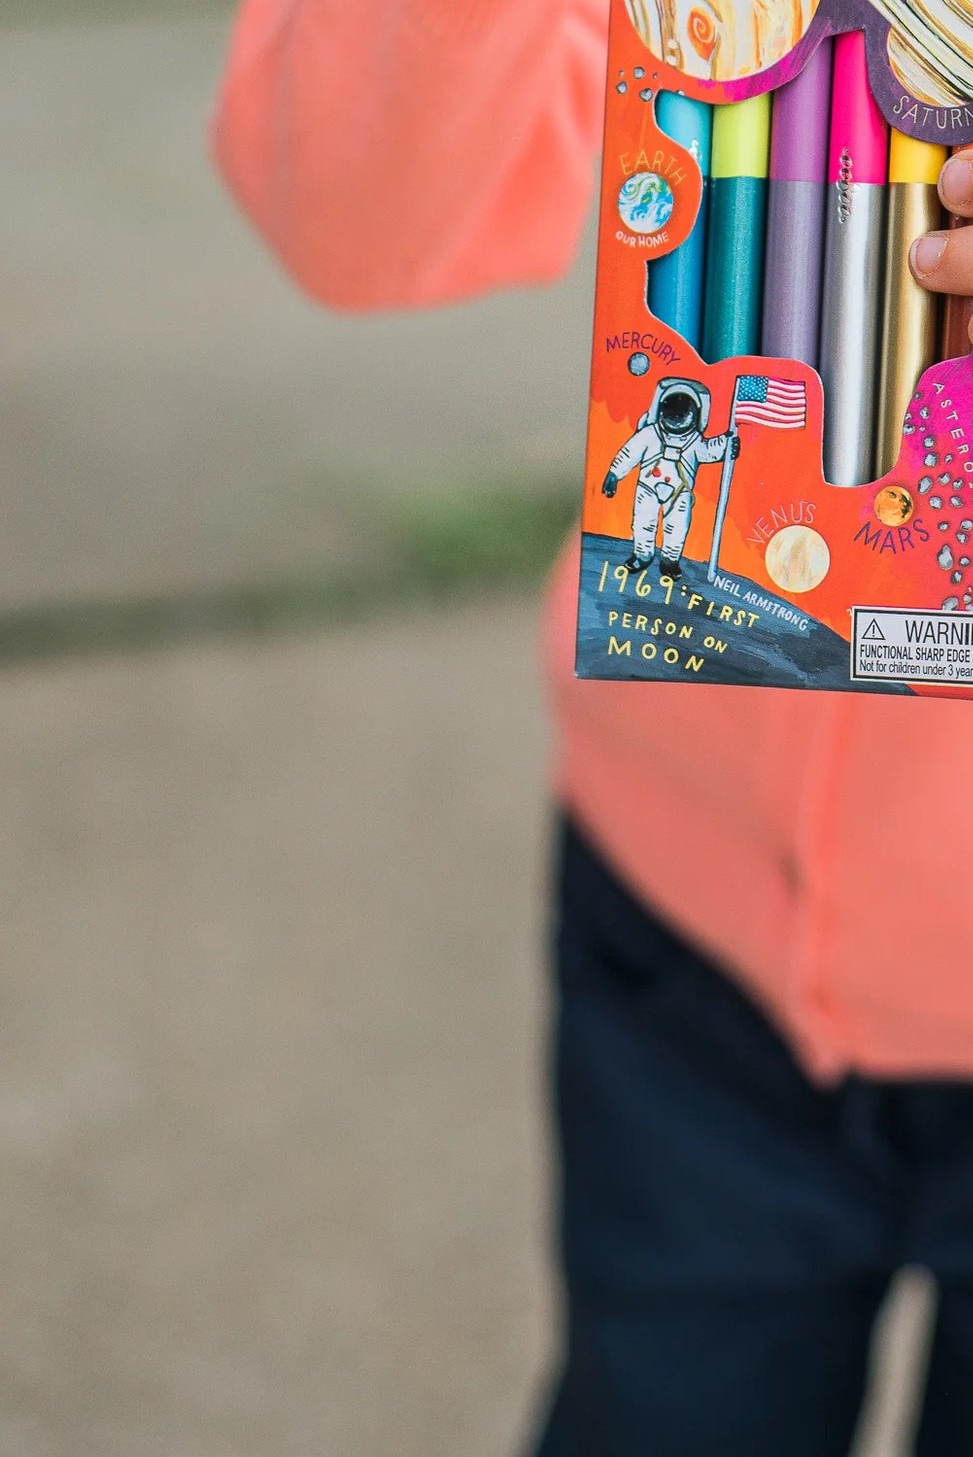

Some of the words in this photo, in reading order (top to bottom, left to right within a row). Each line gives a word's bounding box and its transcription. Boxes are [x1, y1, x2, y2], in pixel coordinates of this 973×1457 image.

[619, 150, 688, 186] EARTH
[615, 230, 636, 248] OUR
[638, 231, 669, 248] HOME
[606, 332, 681, 366] MERCURY
[747, 501, 816, 544] VENUS
[854, 519, 930, 555] MARS
[687, 594, 760, 628] FIRST
[713, 576, 741, 597] NEIL
[742, 591, 809, 631] ARMSTRONG
[608, 611, 693, 639] PERSON
[703, 636, 728, 653] ON
[607, 636, 704, 672] MOON
[860, 644, 914, 660] FUNCTIONAL
[915, 647, 944, 662] SHARP
[947, 649, 970, 663] EDGE
[860, 660, 874, 672] Not
[876, 660, 886, 673] for
[889, 661, 920, 675] children
[923, 664, 946, 676] under
[948, 664, 954, 675] 3
